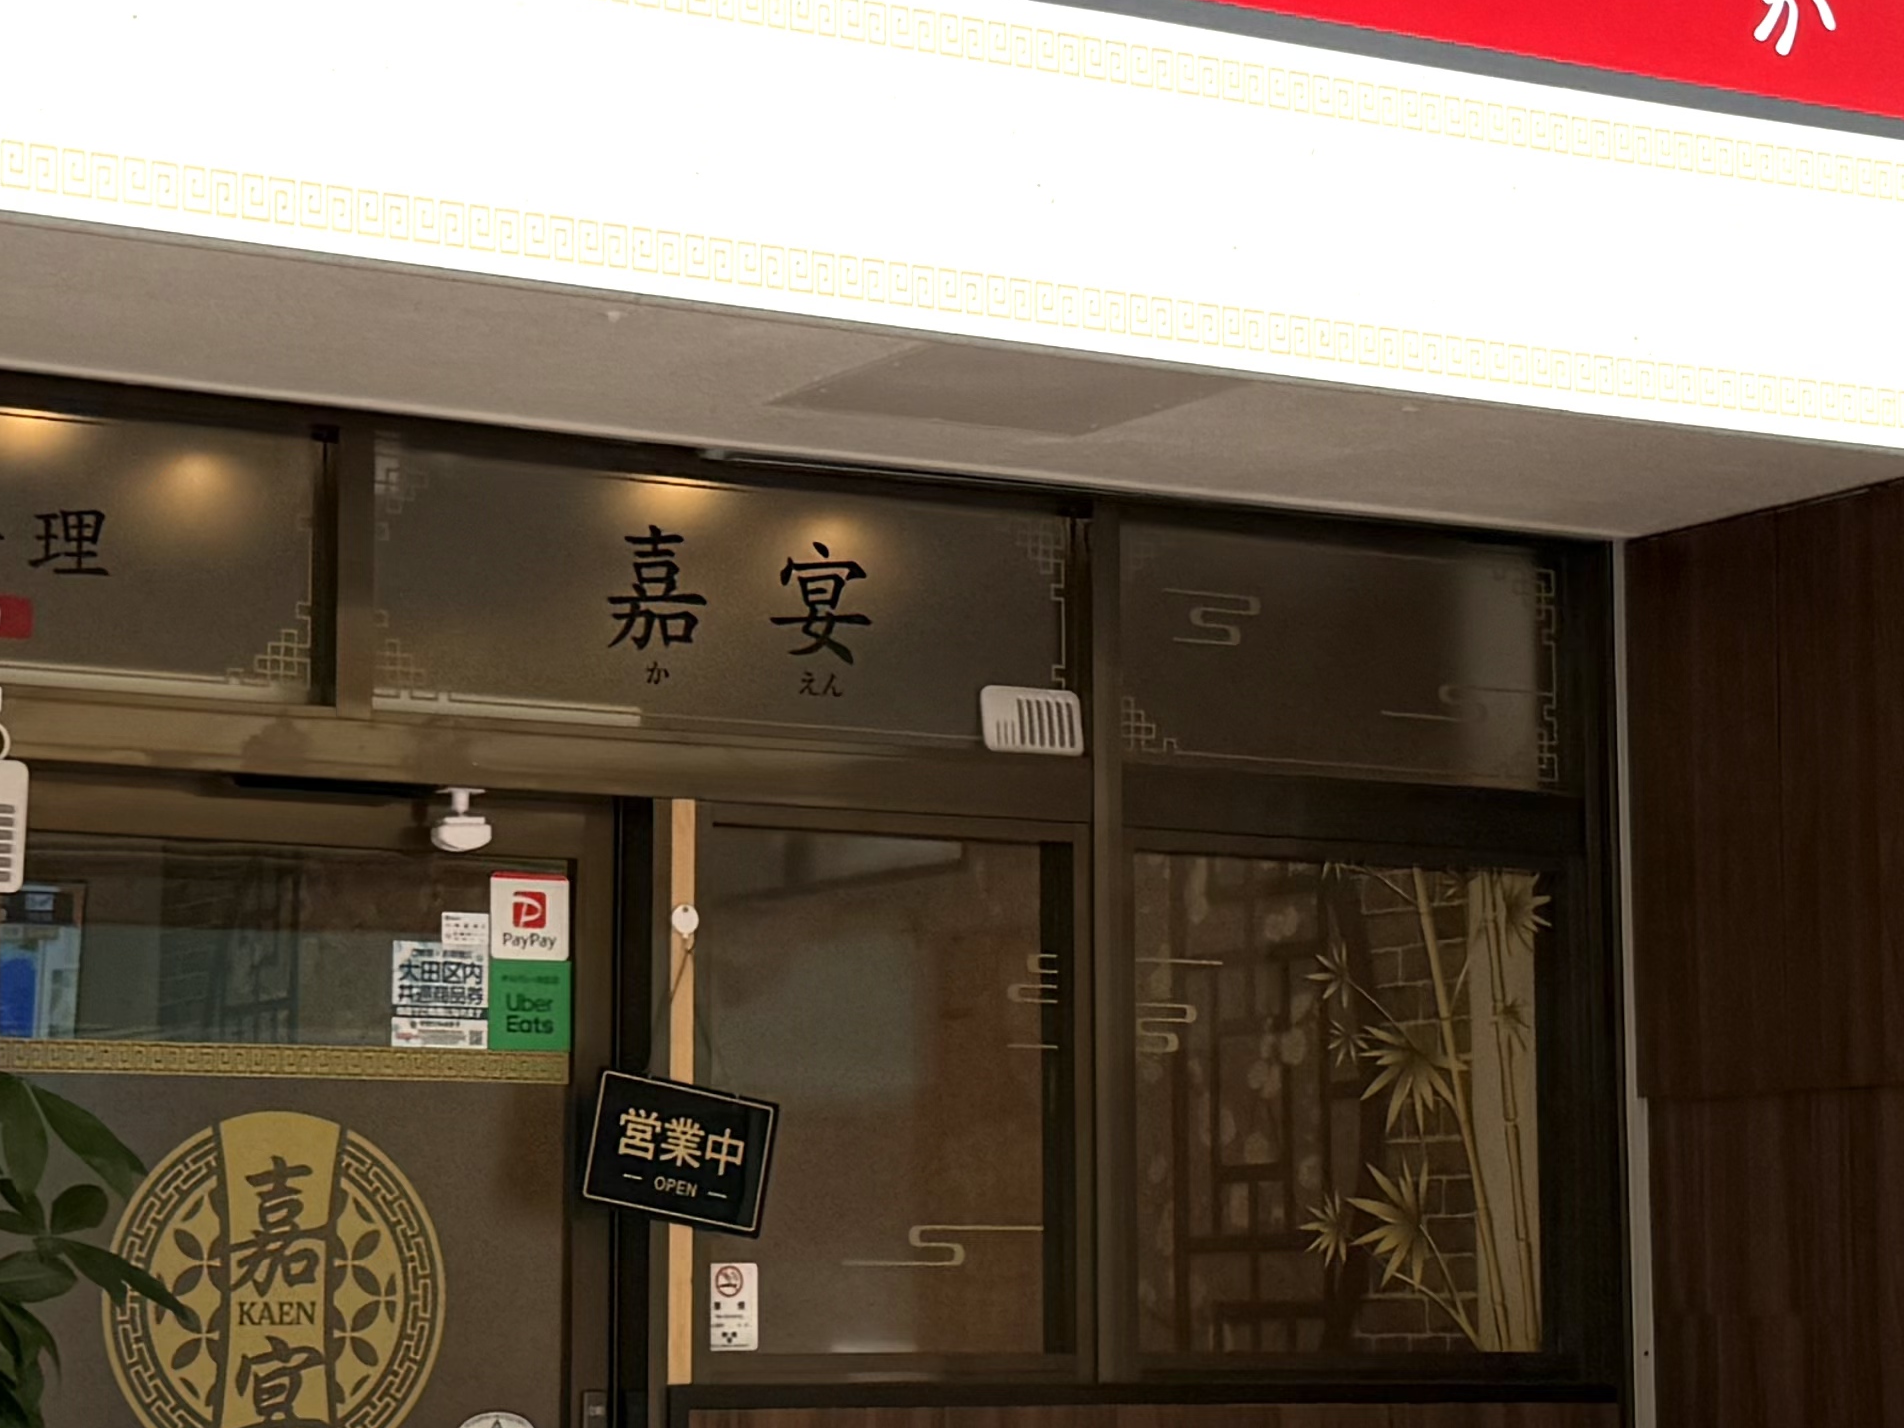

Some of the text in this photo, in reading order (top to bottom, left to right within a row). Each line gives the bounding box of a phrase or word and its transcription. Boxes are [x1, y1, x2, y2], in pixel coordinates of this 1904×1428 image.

[607, 523, 873, 666] 嘉宴
[645, 660, 671, 687] か
[798, 670, 844, 699] えん
[502, 932, 557, 950] PayPay
[505, 993, 554, 1012] Uber
[506, 1015, 554, 1034] Eats
[617, 1106, 747, 1177] 営業中
[653, 1174, 698, 1200] OPEN
[237, 1300, 317, 1327] KAEN
